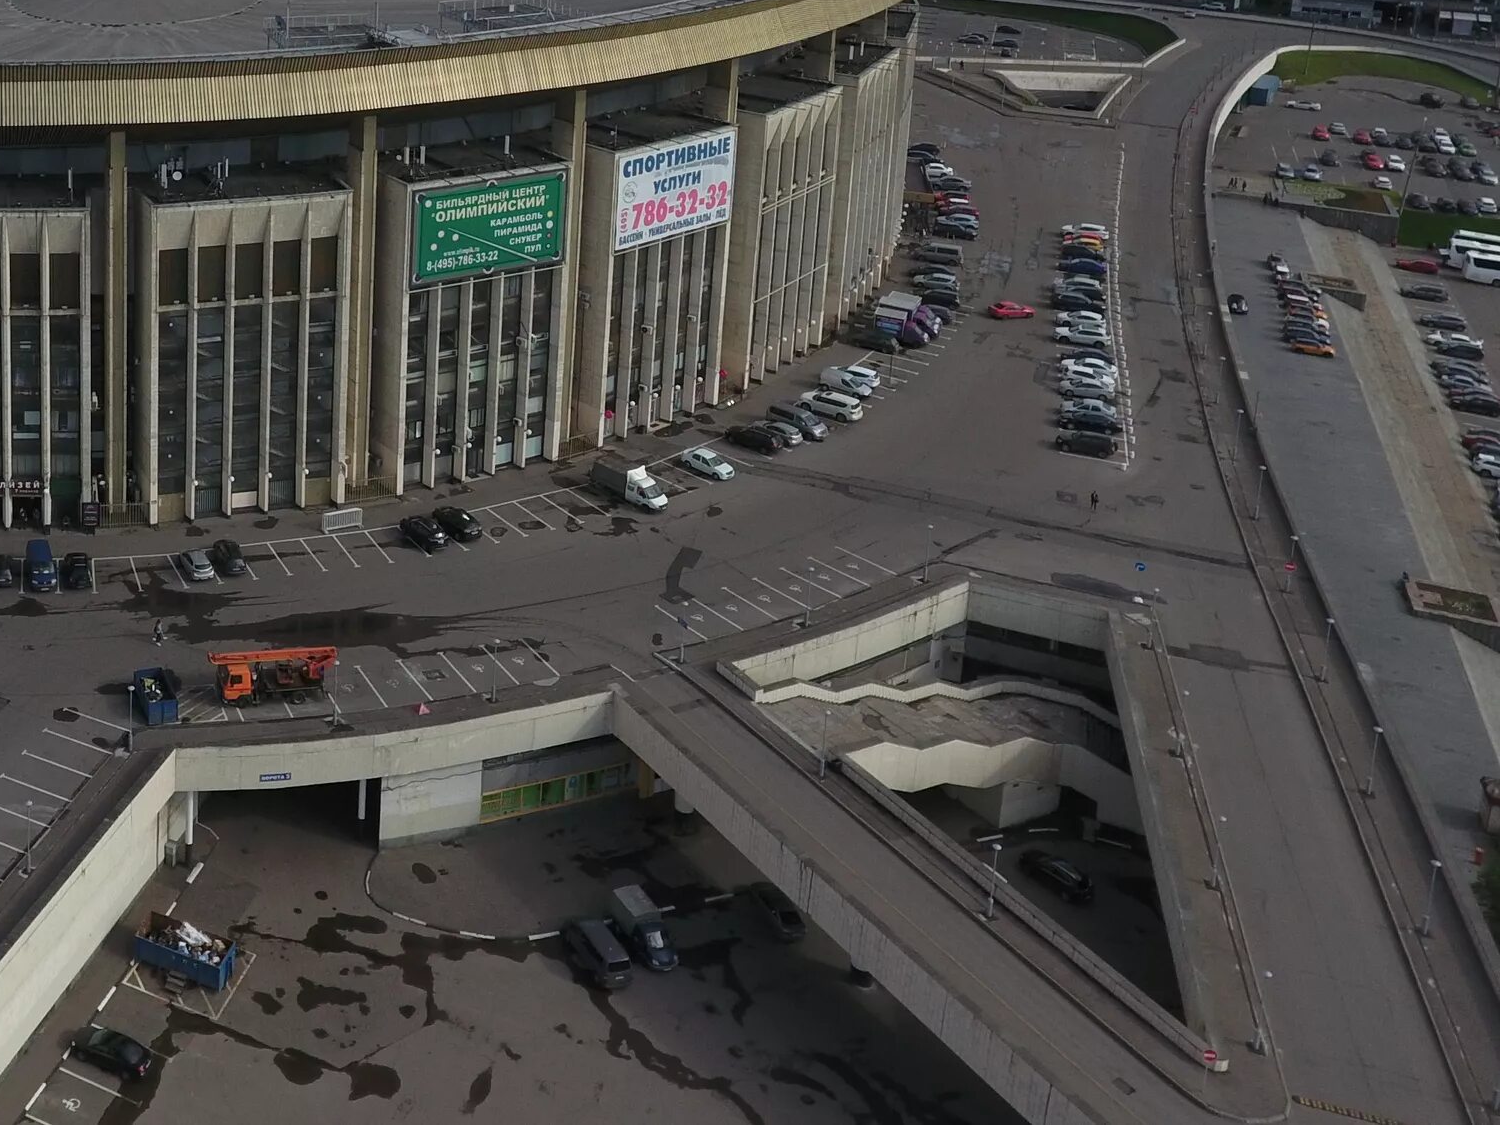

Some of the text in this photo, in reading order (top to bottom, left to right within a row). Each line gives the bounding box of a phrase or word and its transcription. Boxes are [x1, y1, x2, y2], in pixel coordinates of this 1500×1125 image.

[623, 136, 731, 178] СПОРТИВНЫЕ
[653, 170, 702, 195] УСЛУГИ
[436, 185, 546, 209] БИЛЬЯРДНЫЙ ЦЕНТР
[632, 181, 728, 230] 786-32-32
[490, 212, 543, 227] КАРАМБОЛЬ
[494, 223, 543, 238] ПИРАМИДА
[619, 230, 644, 246] БАССЕЙН
[648, 217, 695, 238] УНИВЕРСАЛЬНЫЕ
[695, 213, 712, 224] ЗАЛЫ
[509, 233, 542, 245] СНУКЕР
[524, 244, 542, 254] ПУЛ
[426, 250, 499, 272] 8-(495)-786-33-22
